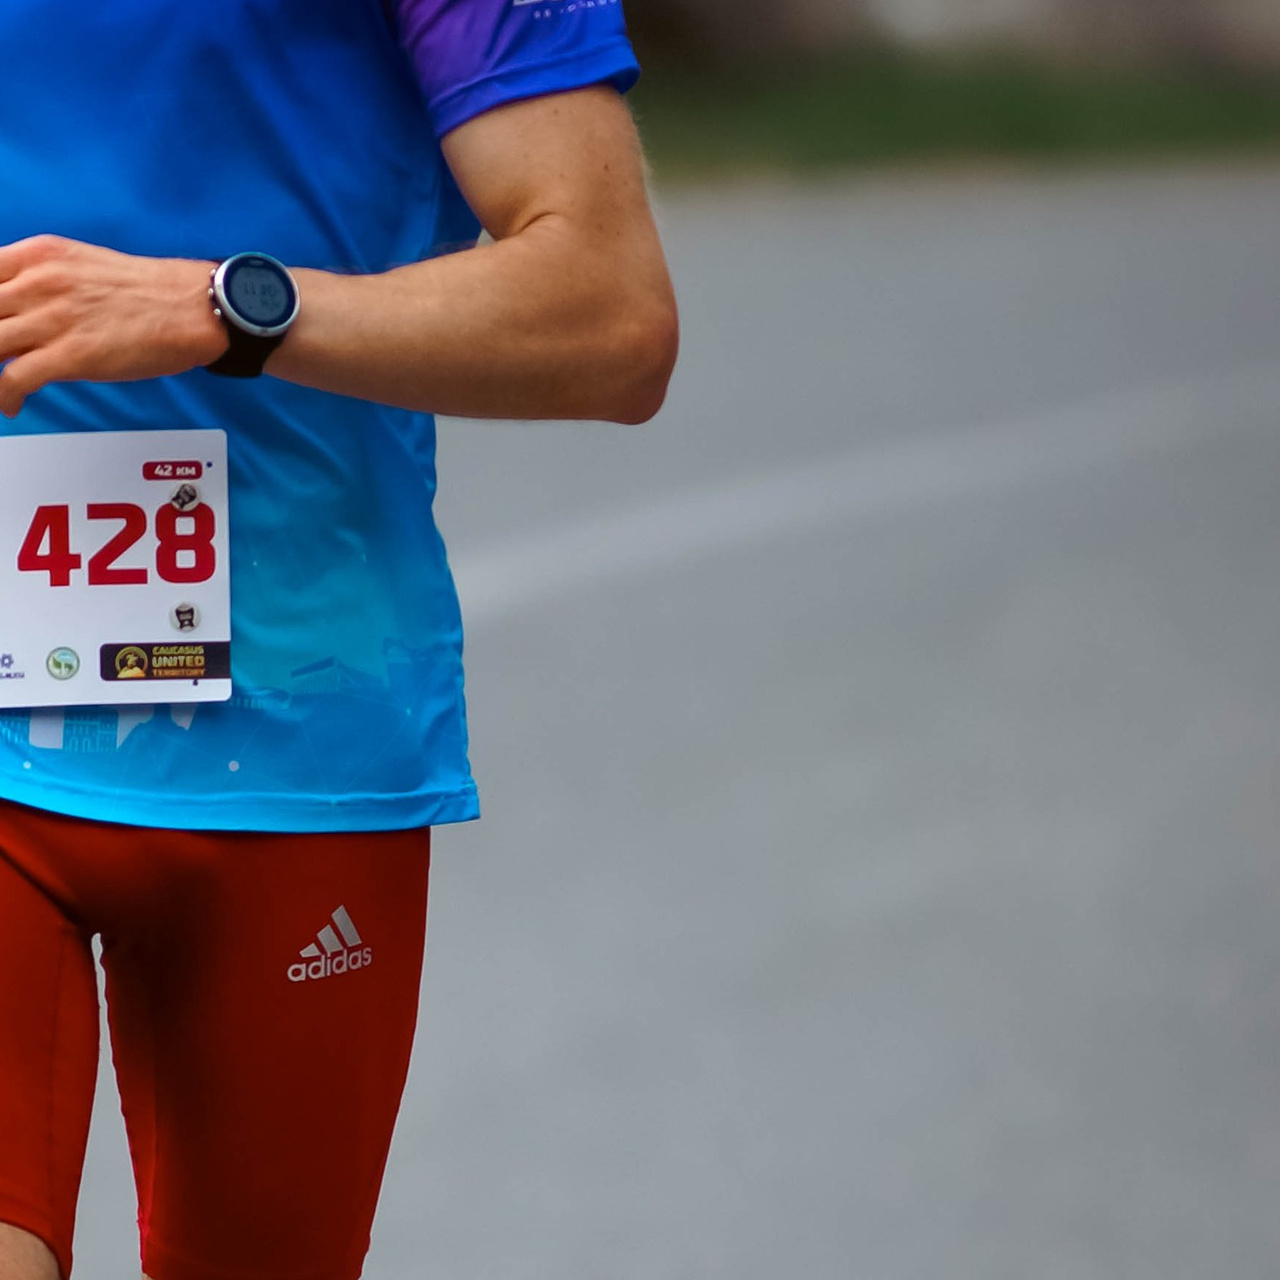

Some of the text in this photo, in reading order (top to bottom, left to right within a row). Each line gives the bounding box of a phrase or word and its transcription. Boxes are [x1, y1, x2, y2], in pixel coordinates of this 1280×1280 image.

[153, 463, 173, 477] 42
[17, 502, 217, 588] 428
[151, 644, 205, 656] CAUCASUS
[151, 655, 206, 668] UNITED
[287, 946, 373, 982] adidas
